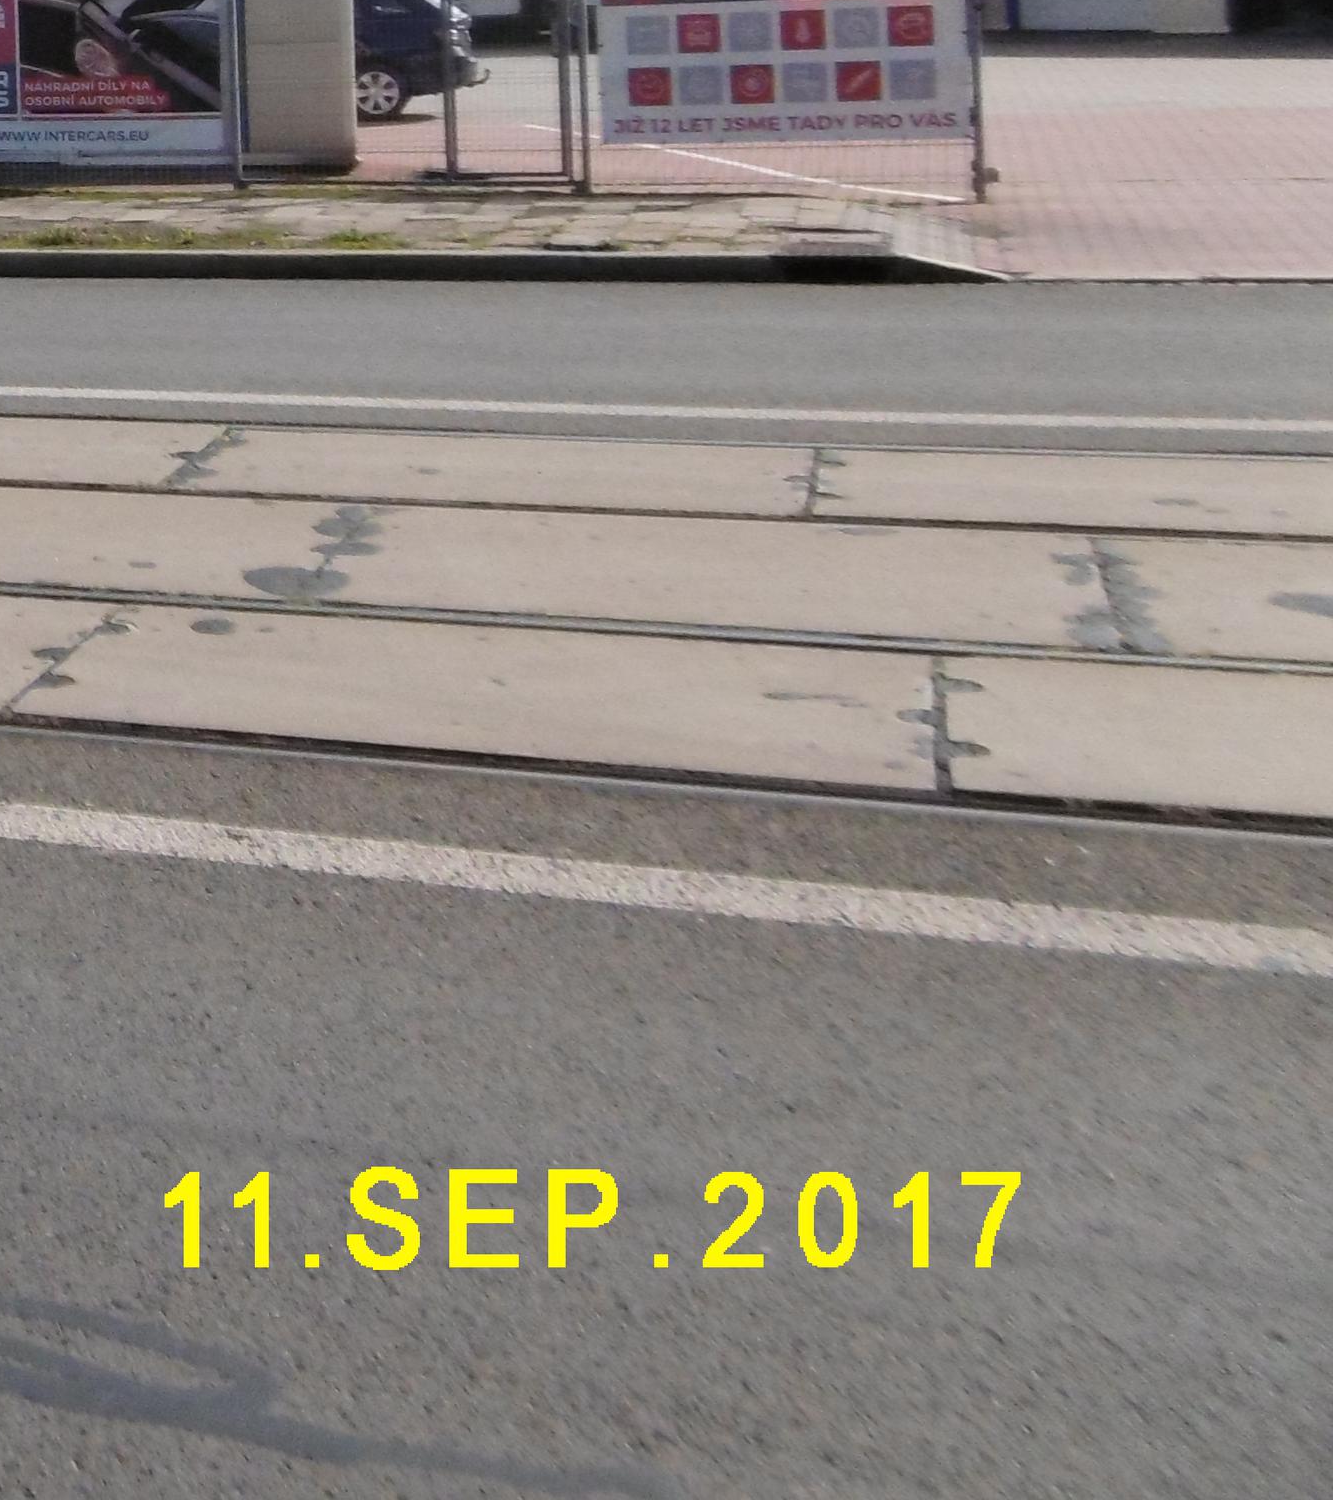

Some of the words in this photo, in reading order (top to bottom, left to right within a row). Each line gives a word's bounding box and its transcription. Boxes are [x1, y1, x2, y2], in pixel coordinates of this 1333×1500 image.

[131, 80, 151, 91] NA
[78, 95, 166, 106] AUTOMOBILY
[613, 114, 646, 134] JIŽ
[650, 117, 672, 134] 12
[677, 117, 715, 133] LET
[722, 115, 781, 132] JSME
[786, 114, 847, 131] TADY
[853, 113, 904, 129] PRO
